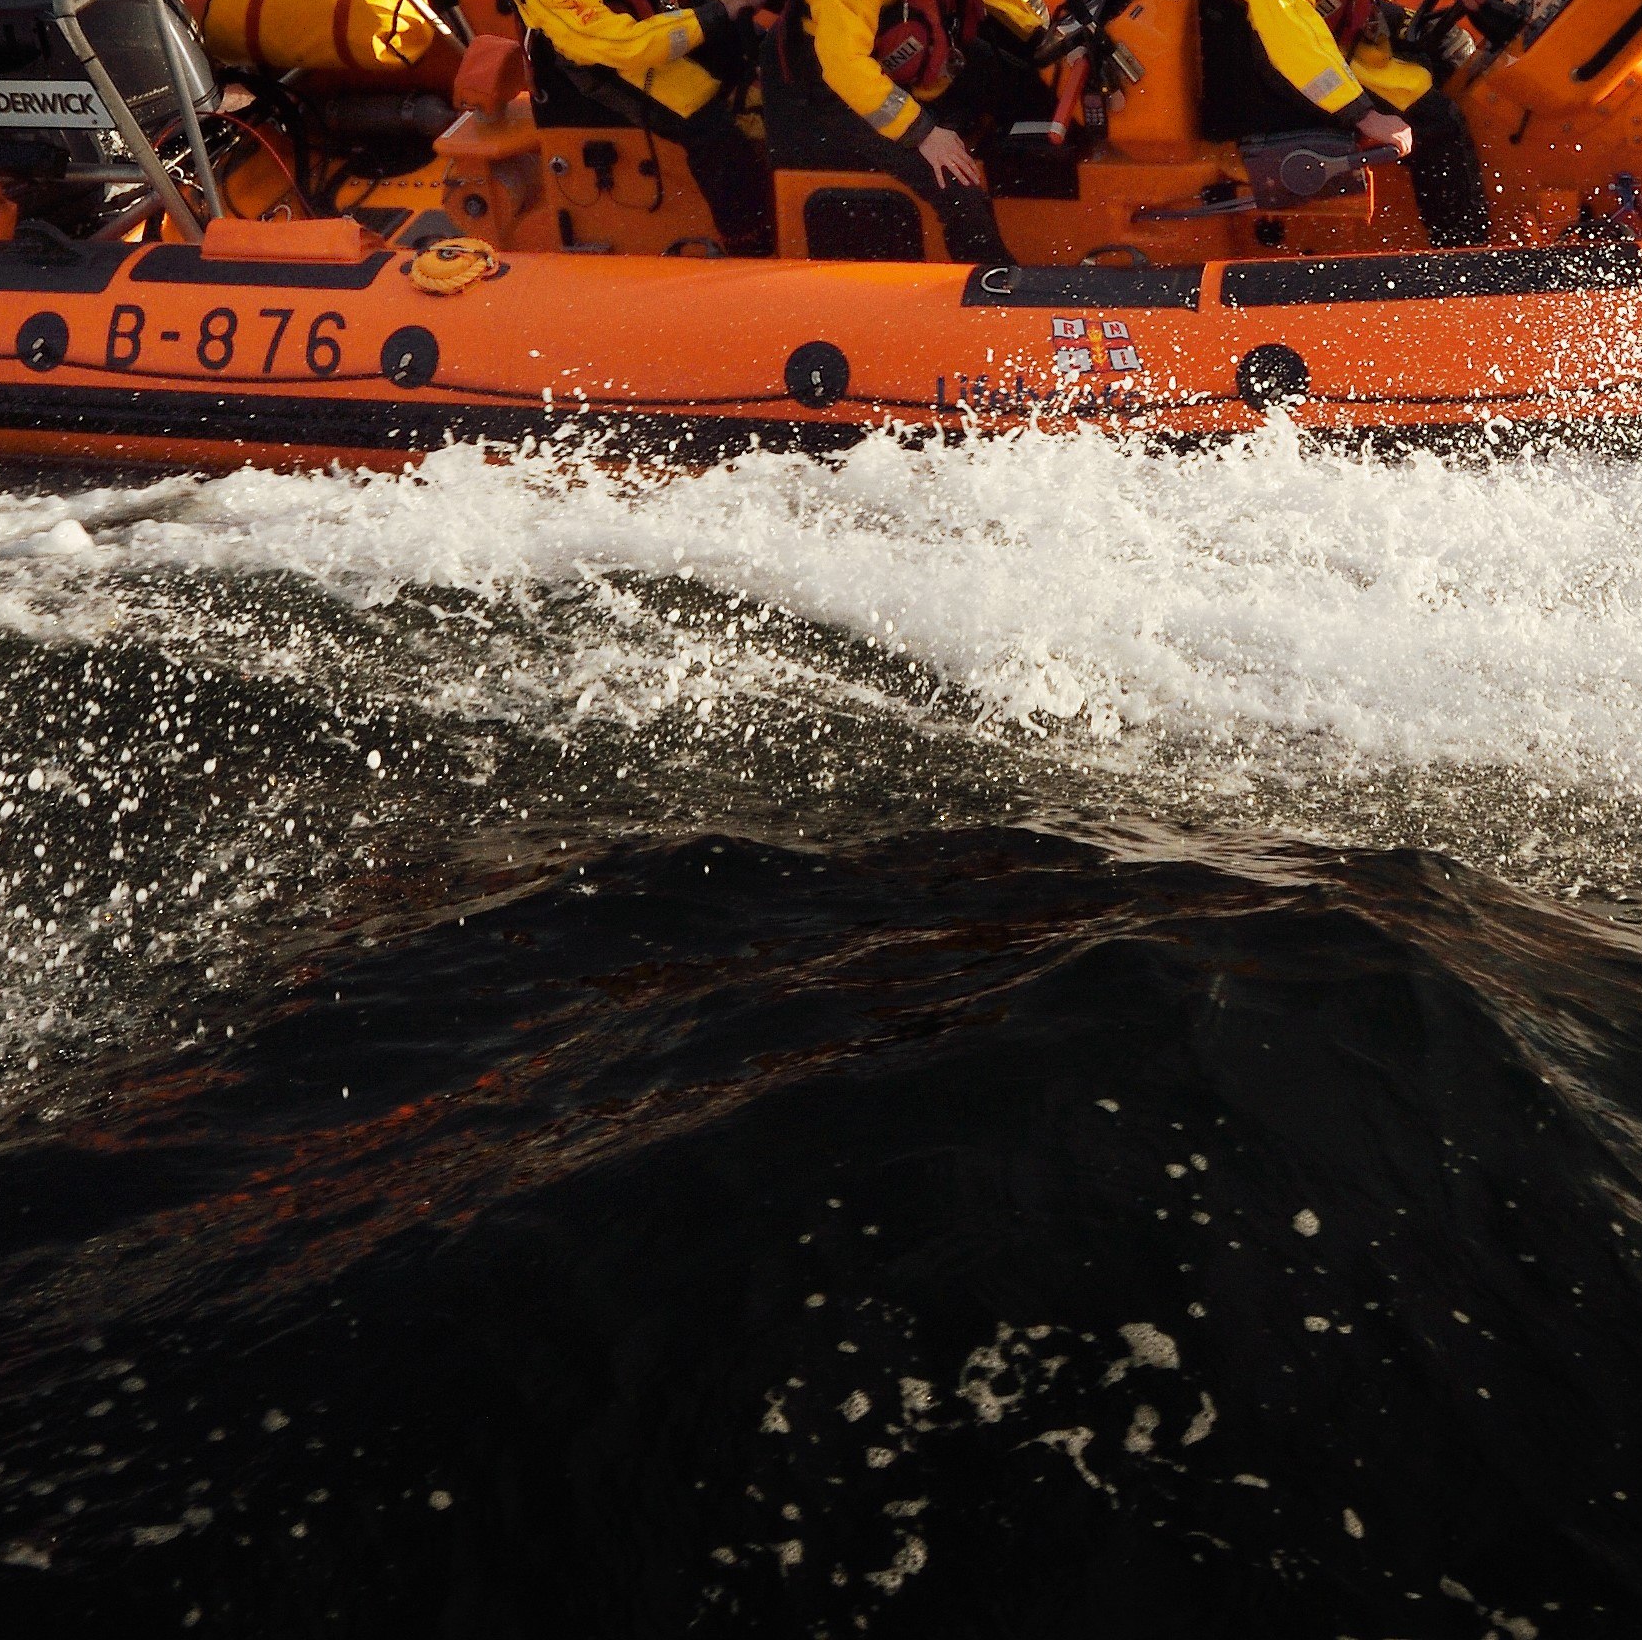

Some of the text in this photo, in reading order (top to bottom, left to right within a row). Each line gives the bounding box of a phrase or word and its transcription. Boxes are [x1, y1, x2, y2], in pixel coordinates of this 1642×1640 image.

[105, 303, 347, 378] B-876
[1062, 321, 1122, 336] R N
